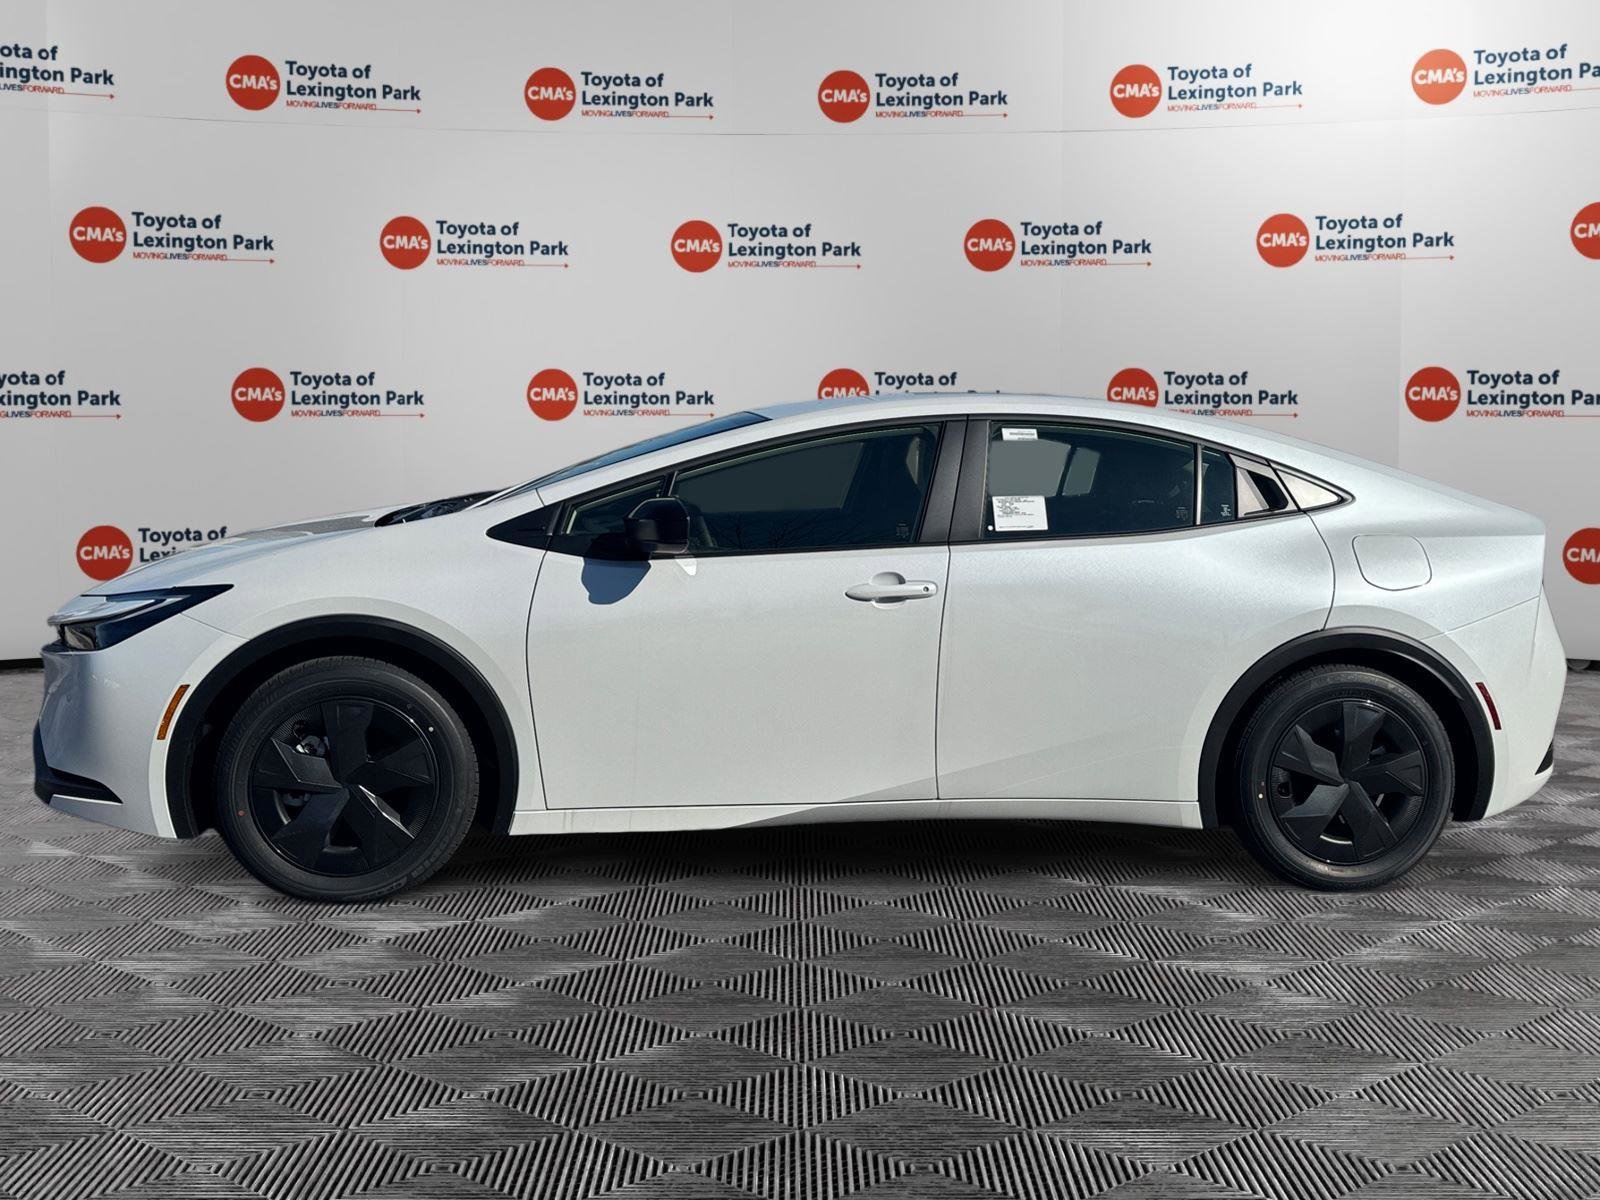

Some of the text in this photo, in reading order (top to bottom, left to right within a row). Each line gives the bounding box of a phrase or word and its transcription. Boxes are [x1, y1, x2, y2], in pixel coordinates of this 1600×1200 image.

[37, 46, 58, 61] of
[1473, 43, 1568, 67] Toyota of
[70, 67, 114, 86] Park
[285, 60, 371, 81] Toyota of
[1167, 63, 1252, 84] Toyota of
[1413, 67, 1464, 86] CMA's
[1474, 67, 1573, 87] Lexington
[228, 73, 278, 91] CMA's
[581, 71, 665, 90] Toyota of
[875, 72, 958, 91] Toyota of
[286, 80, 421, 102] Lexington Park
[527, 85, 574, 101] CMA's
[820, 88, 867, 103] CMA's
[876, 90, 1008, 110] Lexington Park
[1113, 83, 1160, 99] CMA's
[1168, 81, 1302, 103] Lexington Park
[582, 91, 714, 111] Lexington Park
[131, 211, 222, 232] Toyota of
[435, 220, 520, 240] Toyota of
[1020, 221, 1103, 241] Toyota of
[1315, 213, 1403, 234] Toyota of
[72, 226, 124, 243] CMA's
[382, 234, 429, 250] CMA's
[727, 223, 812, 242] Toyota of
[1259, 232, 1307, 248] CMA's
[133, 232, 275, 256] Lexington Park
[437, 239, 569, 259] Lexington Park
[673, 238, 720, 253] CMA's
[728, 242, 861, 261] Lexington Park
[966, 237, 1013, 252] CMA's
[1021, 239, 1152, 260] Lexington Park
[1316, 232, 1455, 254] Lexington Park
[45, 370, 65, 386] of
[290, 371, 376, 391] Toyota of
[582, 371, 666, 391] Toyota of
[874, 371, 957, 391] Toyota of
[1164, 370, 1249, 391] Toyota of
[1466, 369, 1561, 390] Toyota of
[77, 390, 121, 406] Park
[234, 386, 283, 402] CMA's
[291, 390, 425, 410] Lexington Park
[529, 386, 576, 401] CMA's
[584, 391, 715, 410] Lexington Park
[1110, 387, 1156, 401] CMA's
[1164, 390, 1299, 409] Lexington Park
[1408, 386, 1458, 402] CMA's
[1467, 390, 1565, 410] Lexington
[137, 525, 228, 547] Toyota of
[79, 543, 130, 561] CMA's
